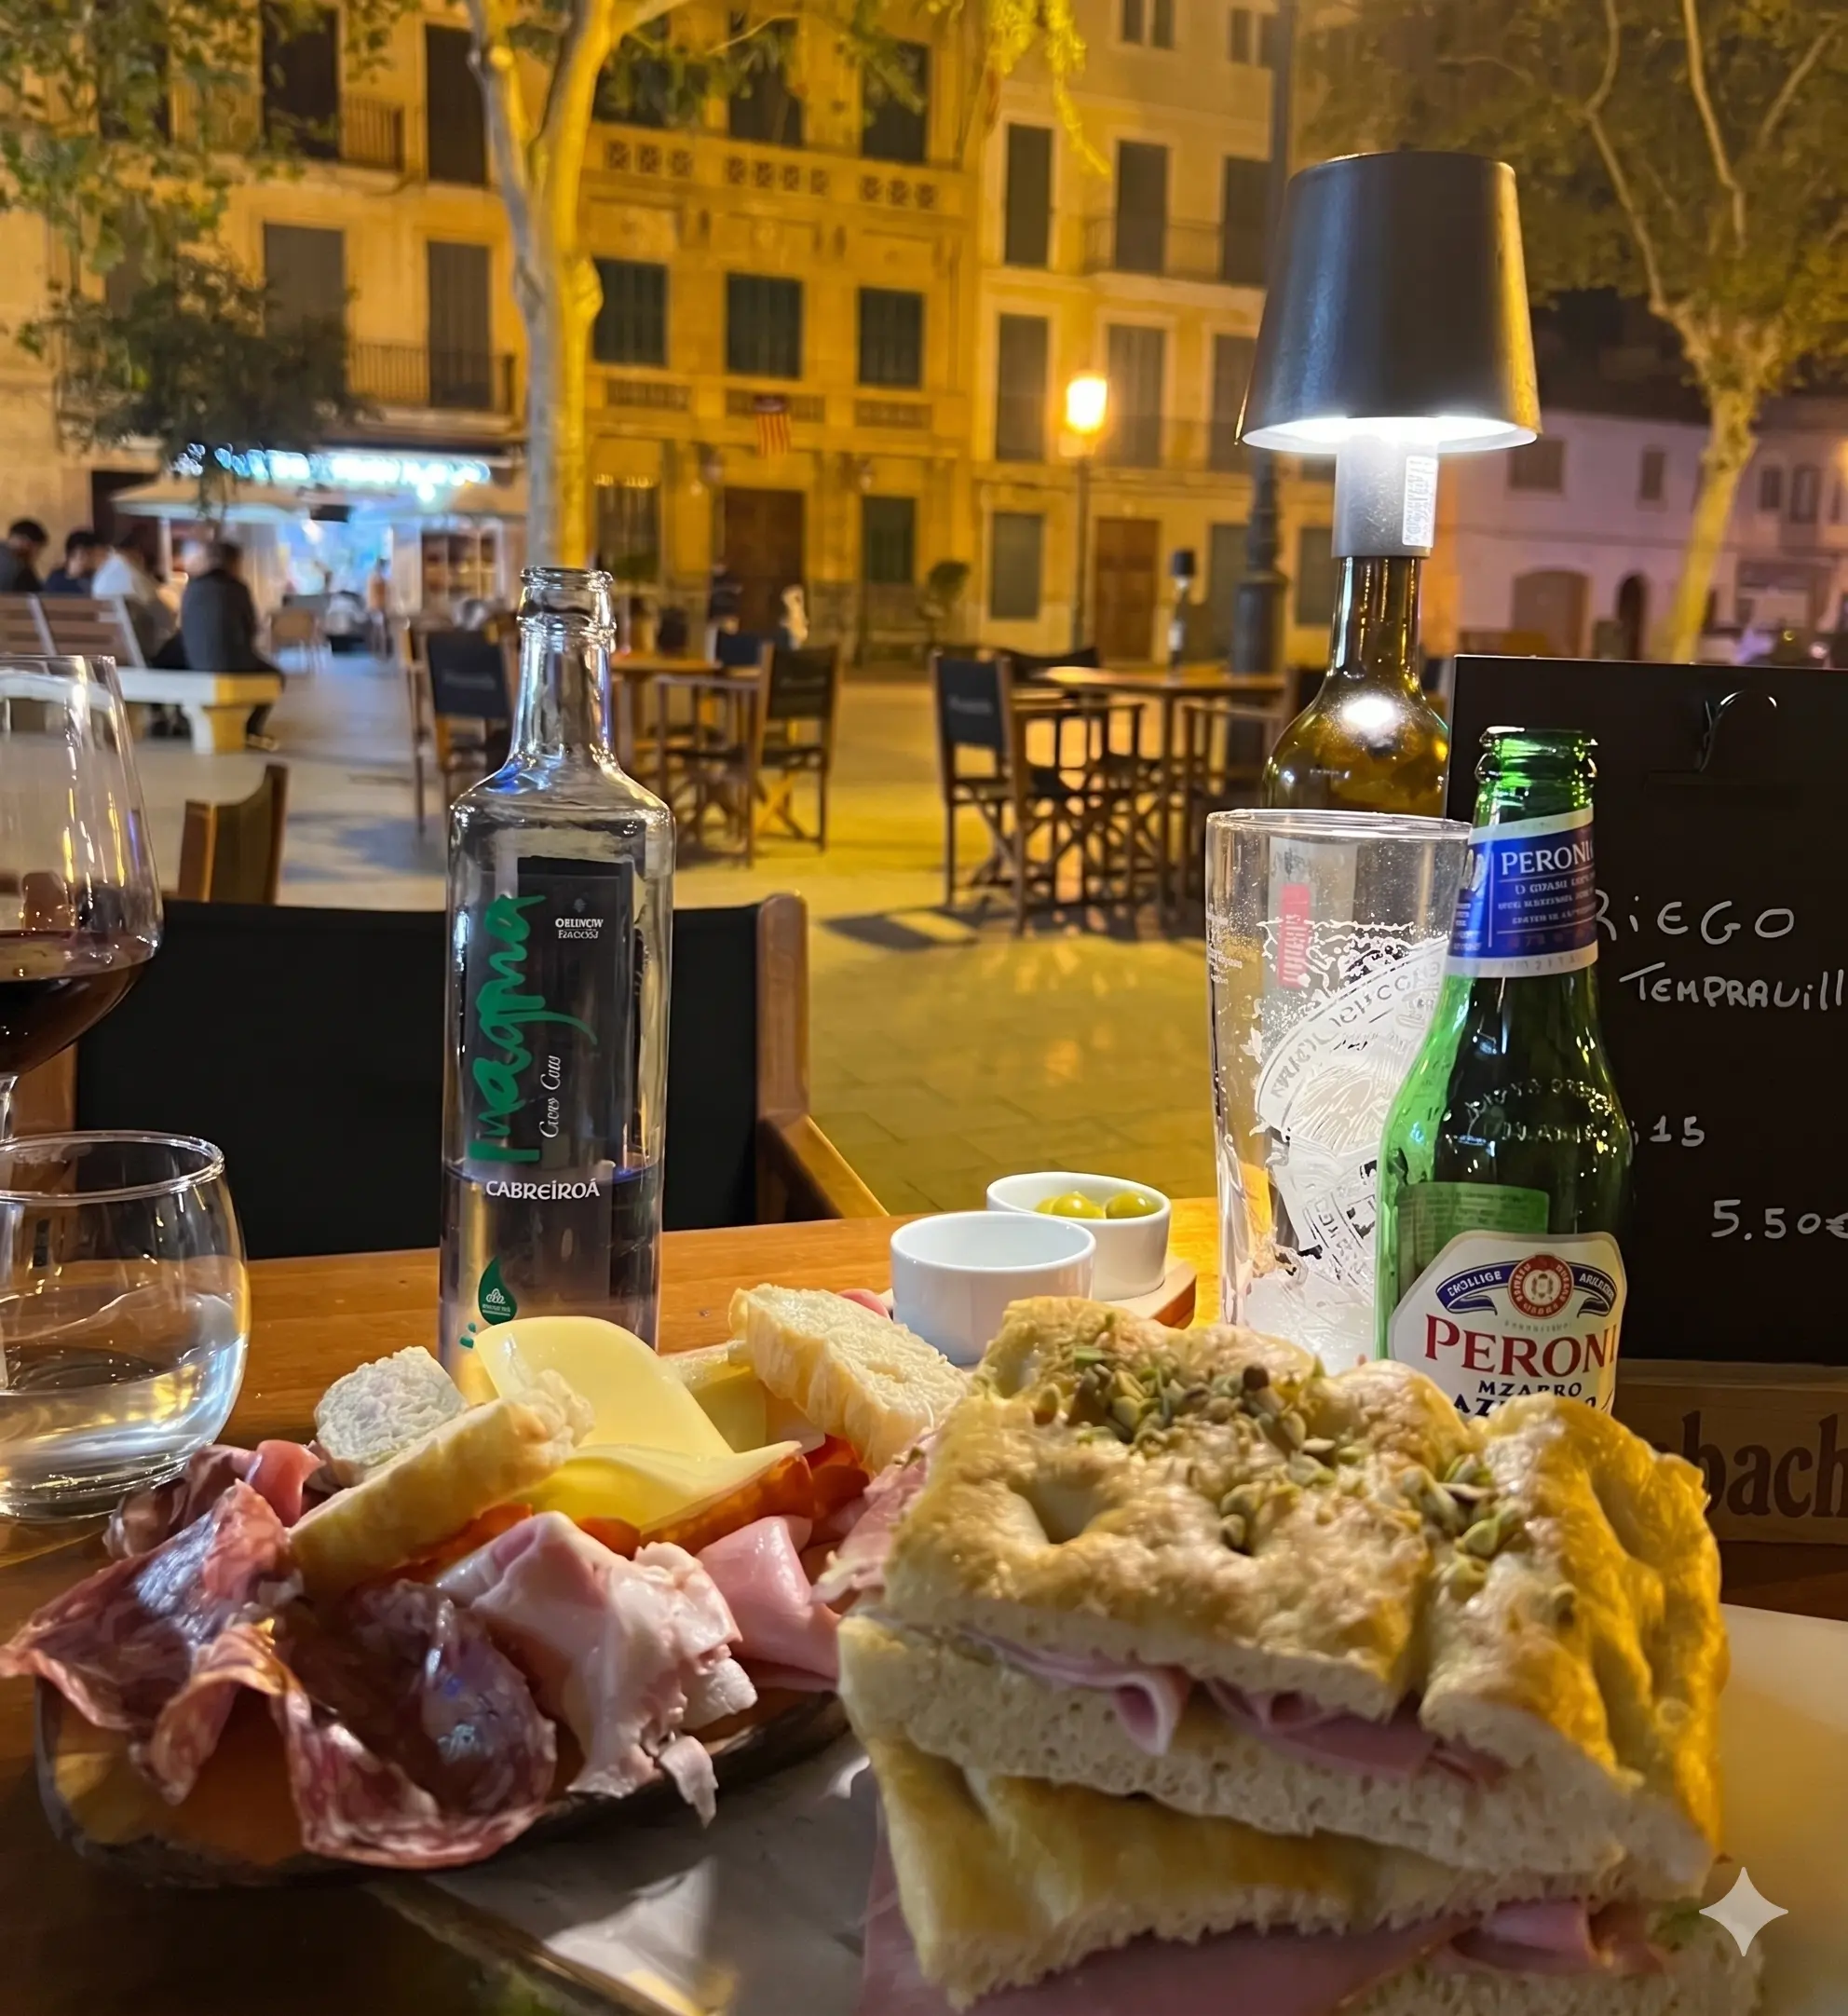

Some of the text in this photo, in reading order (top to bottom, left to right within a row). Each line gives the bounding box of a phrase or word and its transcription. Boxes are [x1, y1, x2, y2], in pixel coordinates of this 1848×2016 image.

[1631, 1115, 1705, 1147] 15
[1425, 1314, 1617, 1379] PERONI
[1653, 1410, 1848, 1519] bach
